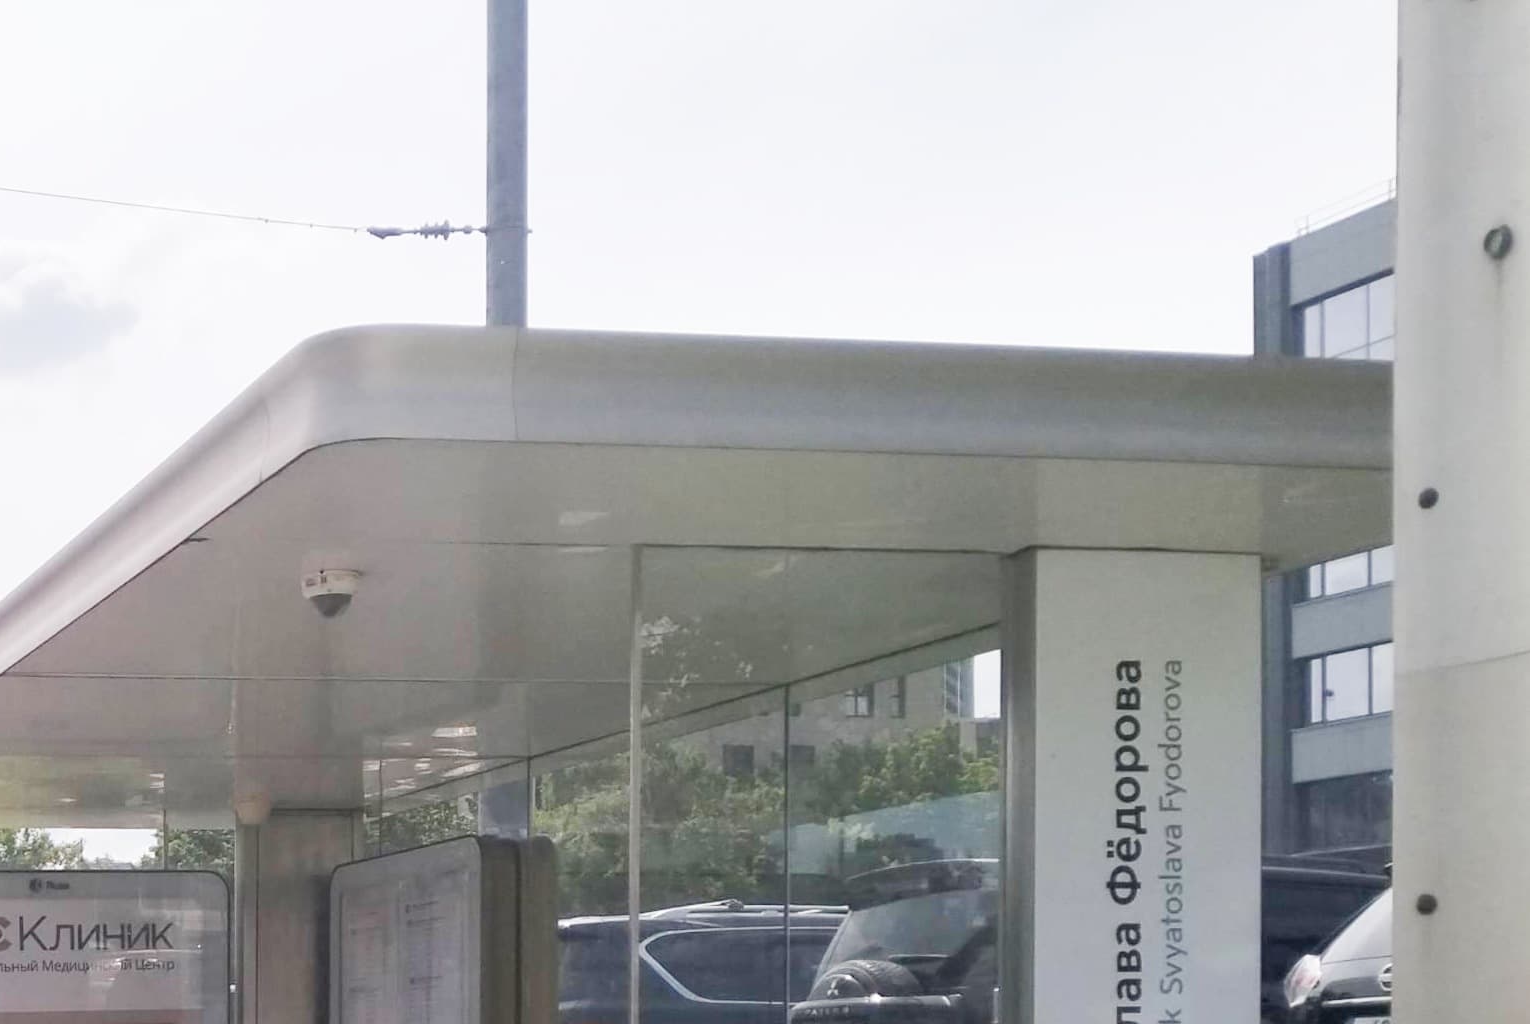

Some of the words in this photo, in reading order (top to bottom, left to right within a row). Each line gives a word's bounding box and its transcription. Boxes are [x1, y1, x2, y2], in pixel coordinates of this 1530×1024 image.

[1106, 660, 1149, 905] Фёдорова
[1157, 660, 1187, 812] Fyodorova
[18, 915, 174, 951] Клиник
[135, 959, 175, 972] Центр
[1158, 824, 1188, 995] Svyatoslava
